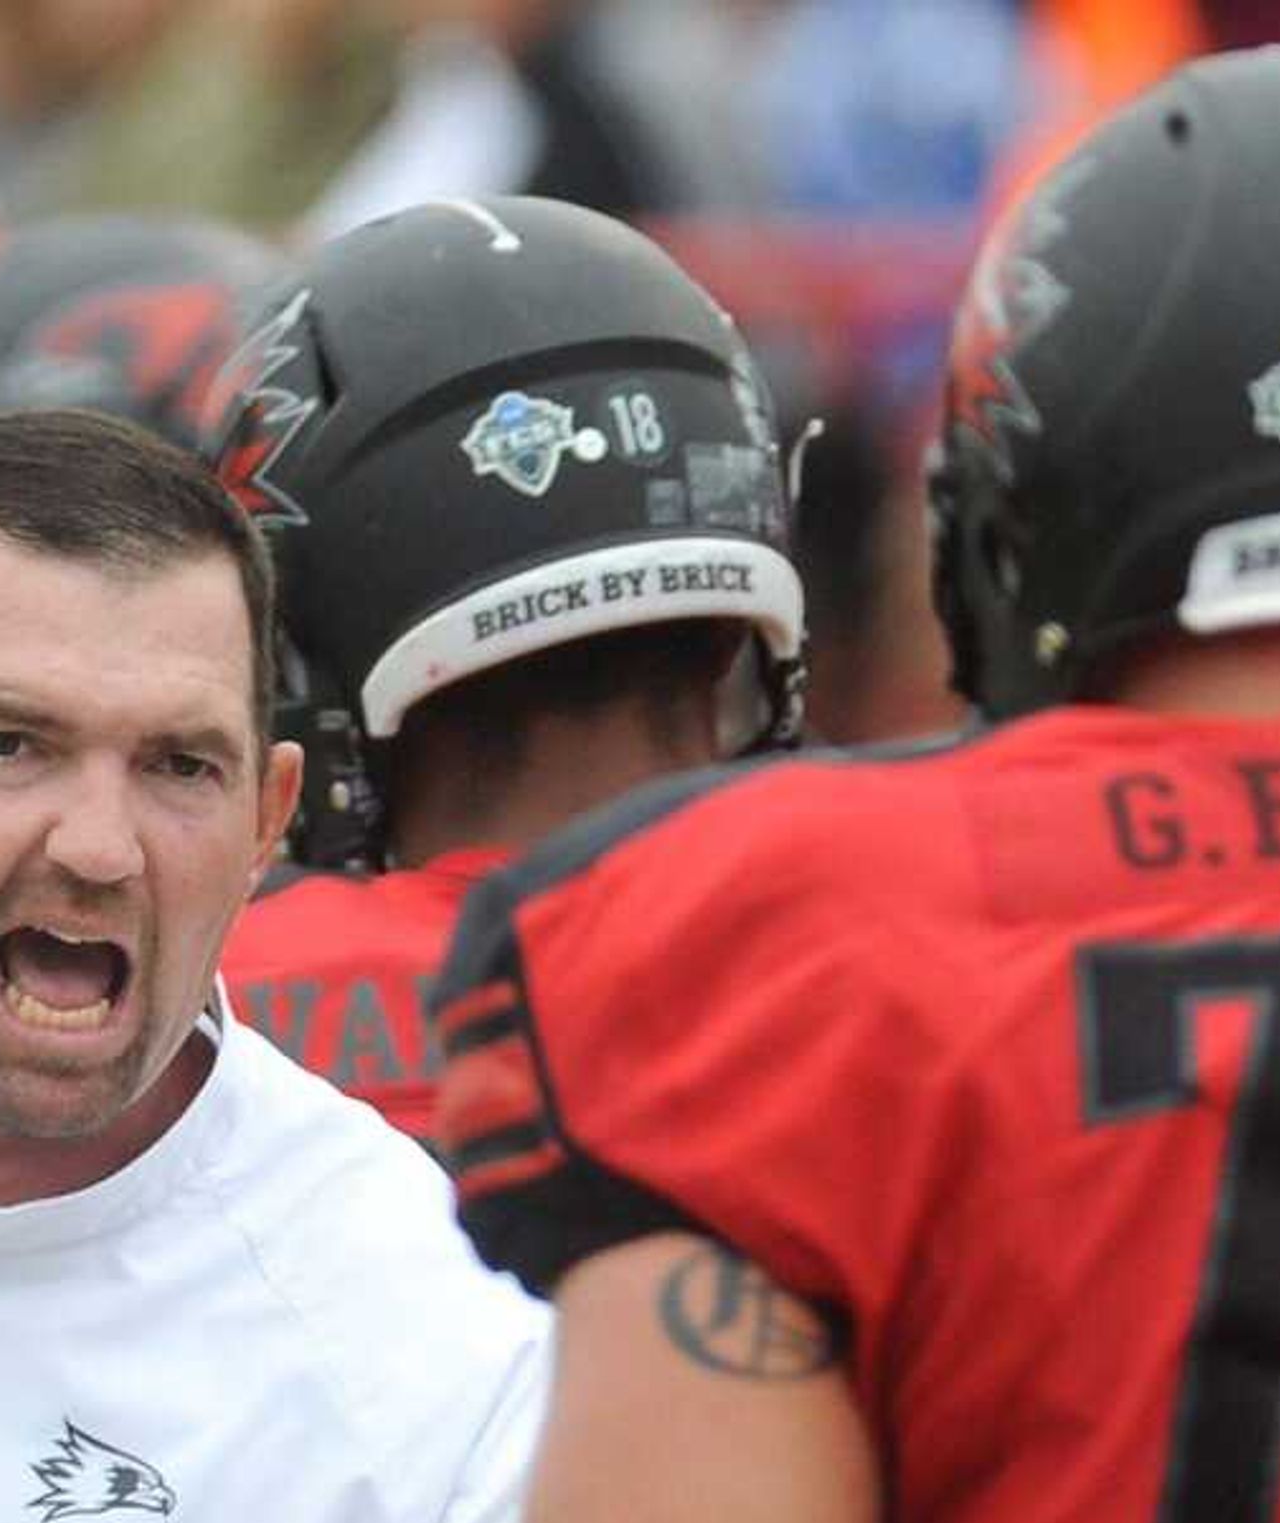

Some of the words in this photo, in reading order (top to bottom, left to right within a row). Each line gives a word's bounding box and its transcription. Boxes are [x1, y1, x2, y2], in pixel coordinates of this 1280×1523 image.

[608, 392, 664, 456] 18
[472, 580, 590, 642] BRICK
[601, 566, 647, 604] BY
